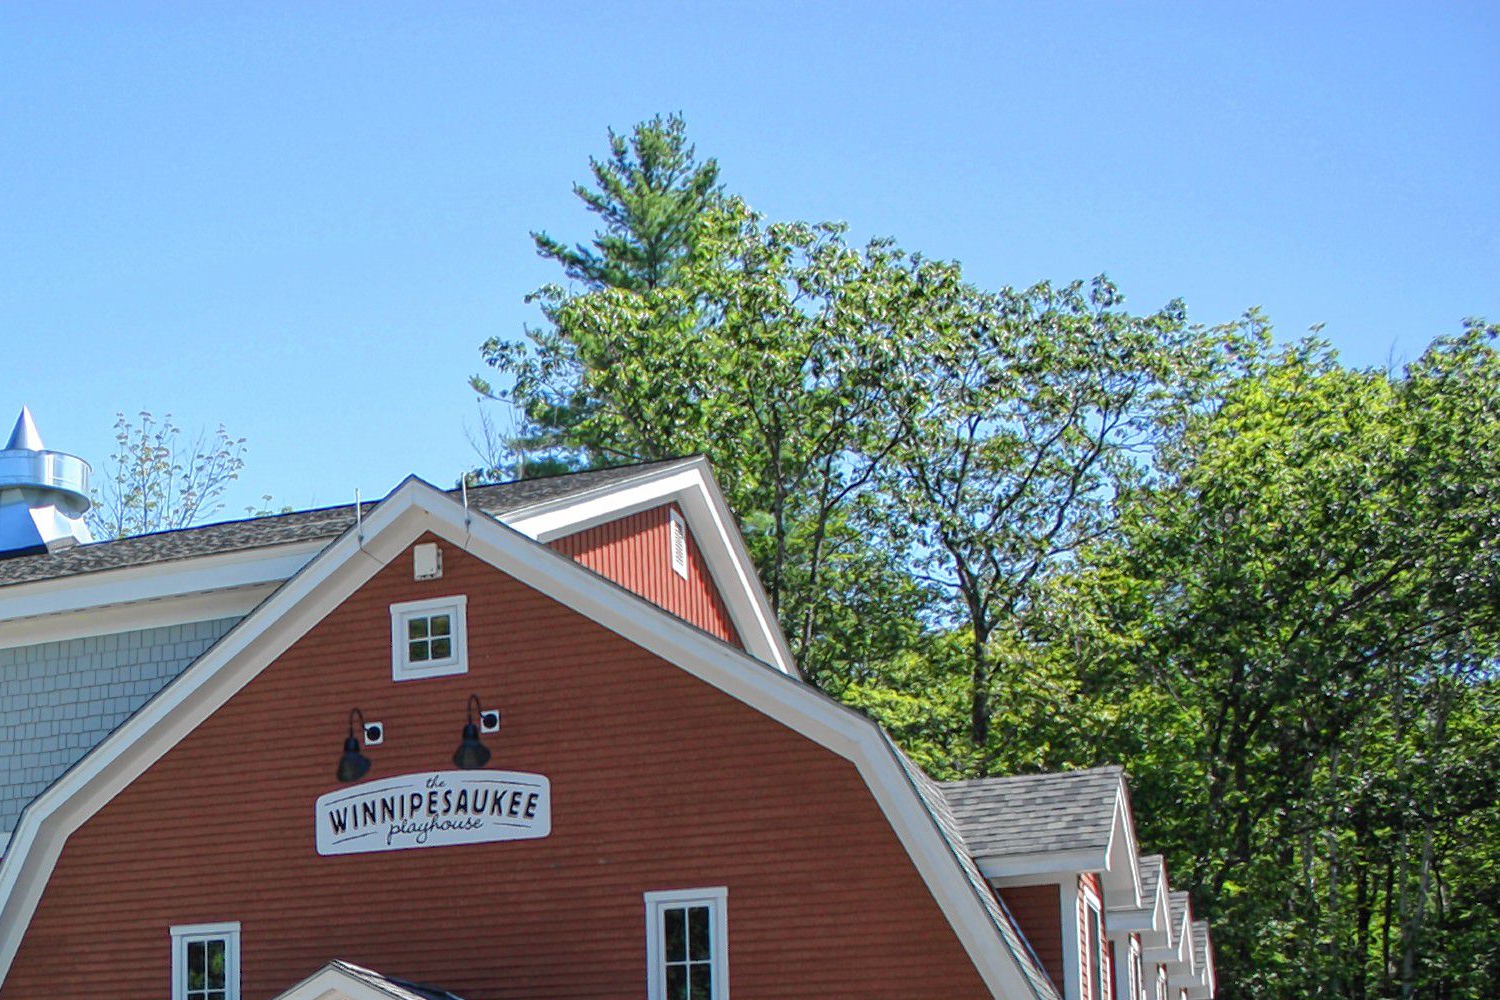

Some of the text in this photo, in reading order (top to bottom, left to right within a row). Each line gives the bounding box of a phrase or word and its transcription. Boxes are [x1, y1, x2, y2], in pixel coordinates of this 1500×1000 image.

[425, 774, 446, 788] the
[328, 788, 540, 835] WINNIPESAUKEE
[386, 813, 484, 845] playhouse
